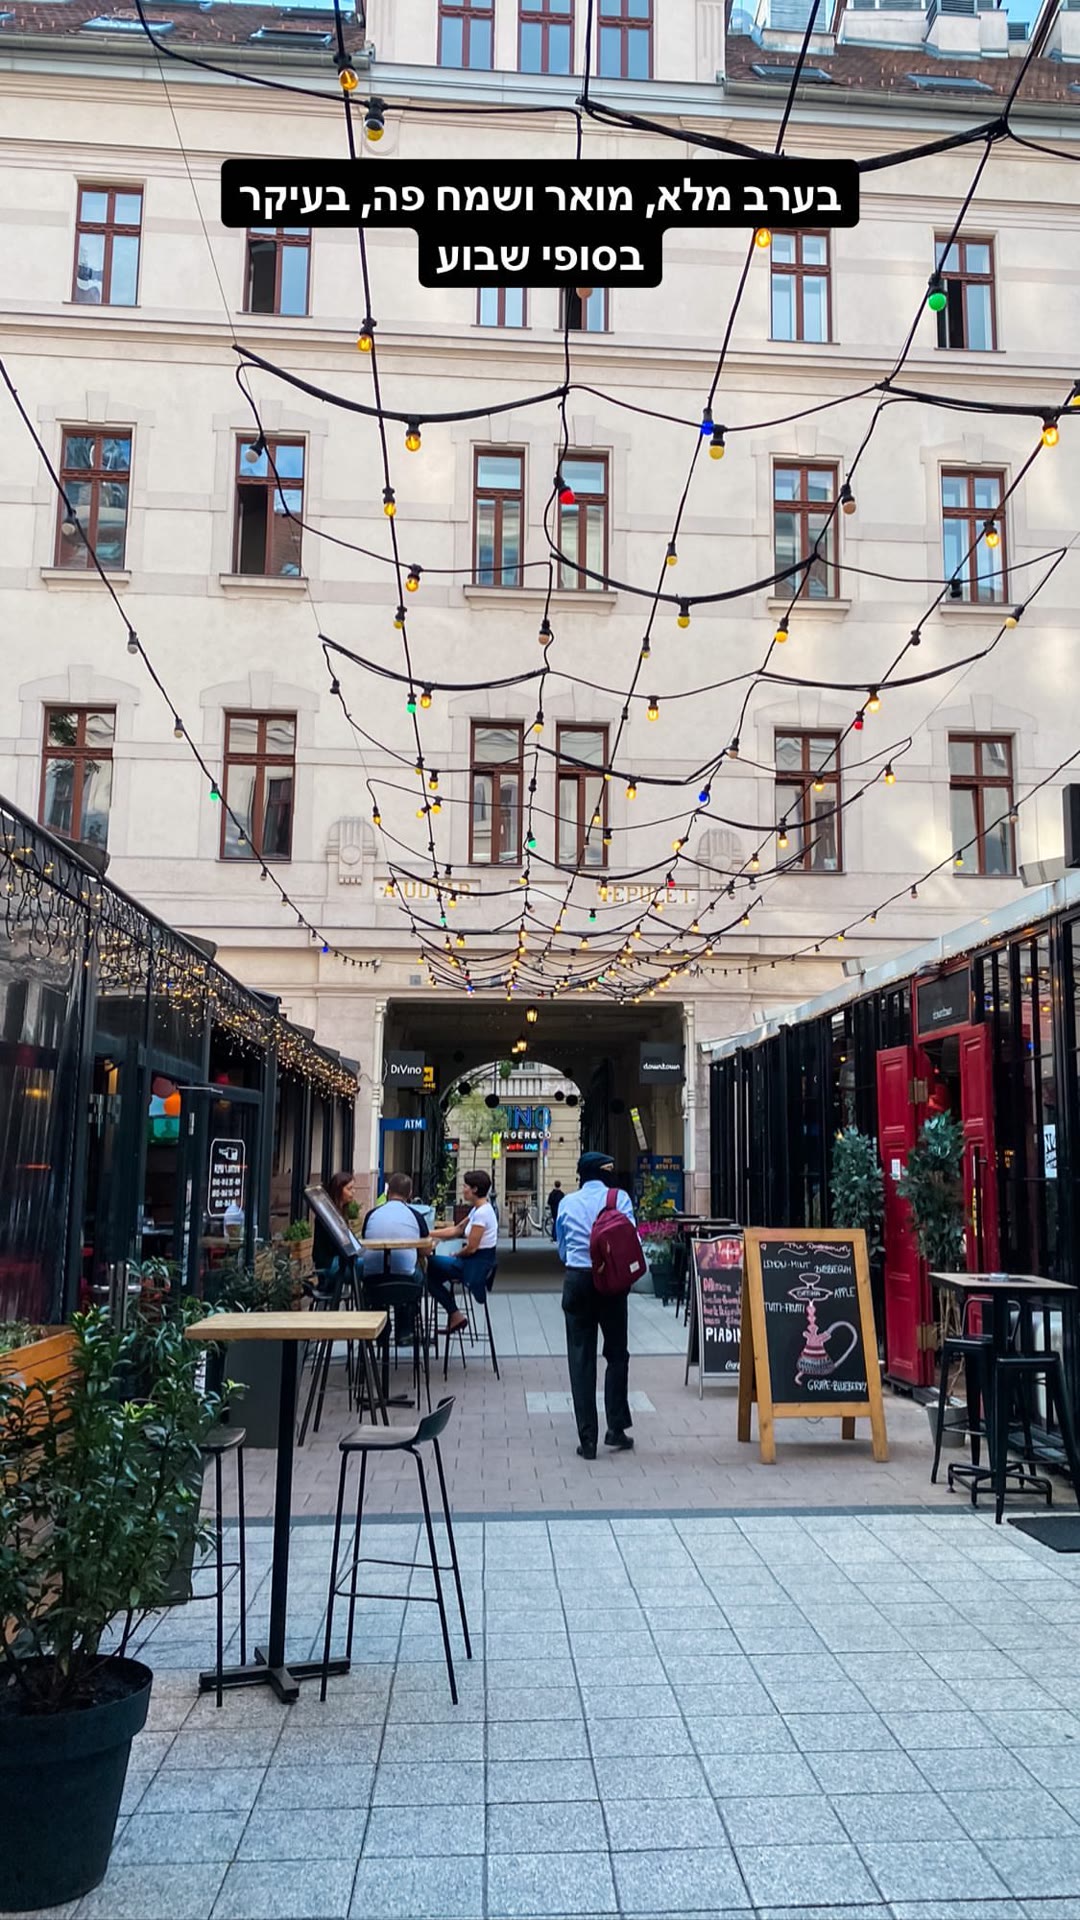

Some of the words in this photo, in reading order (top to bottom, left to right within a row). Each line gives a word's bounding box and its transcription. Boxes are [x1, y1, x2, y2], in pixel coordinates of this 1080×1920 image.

[390, 1064, 422, 1075] DiVino
[404, 1119, 423, 1129] ATM
[490, 1131, 552, 1140] RGER&CO
[834, 1286, 856, 1299] APPLE
